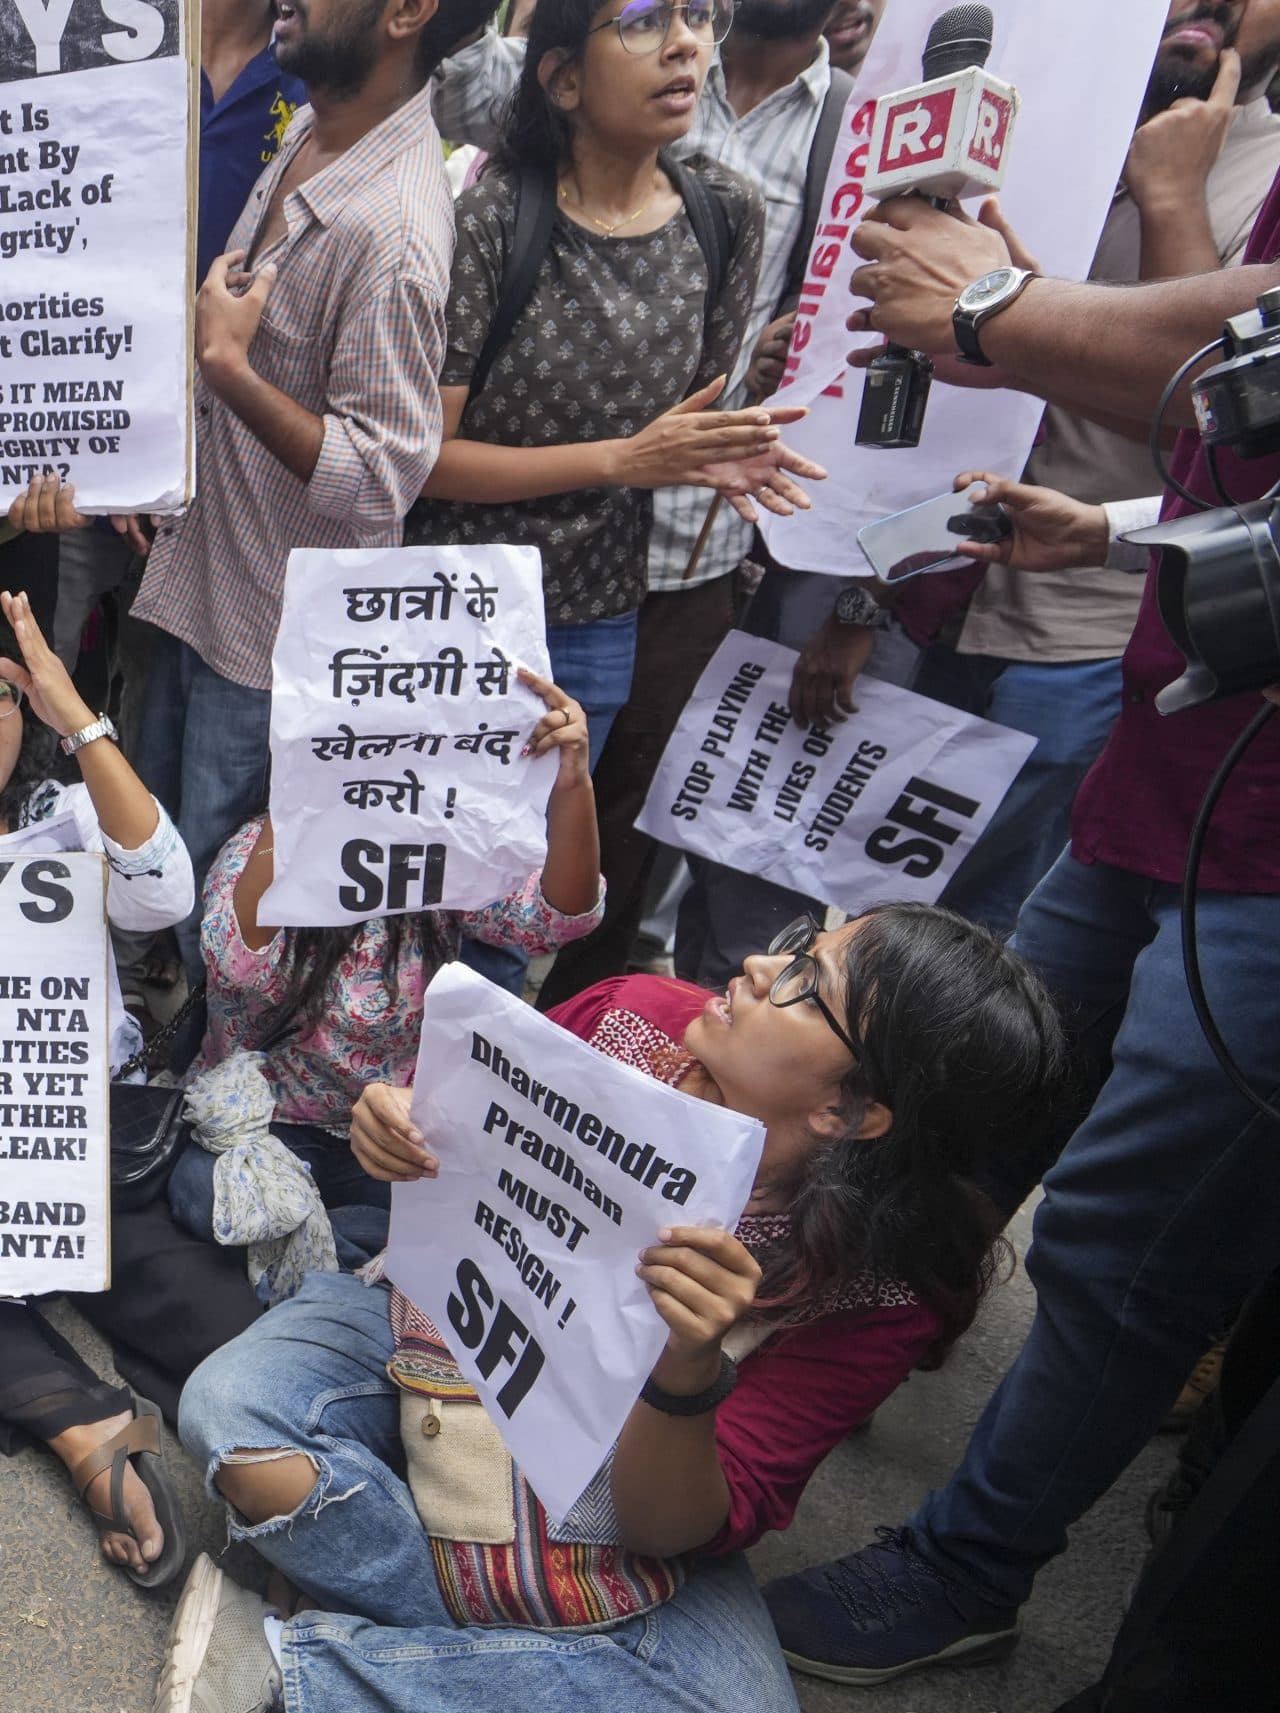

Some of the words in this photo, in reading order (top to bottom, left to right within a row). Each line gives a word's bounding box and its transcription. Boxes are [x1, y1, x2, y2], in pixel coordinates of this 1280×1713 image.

[21, 102, 49, 132] Is
[38, 140, 80, 174] By
[81, 174, 113, 204] of
[20, 325, 133, 360] Clarify!
[10, 383, 36, 404] IT
[43, 380, 124, 403] MEAN
[343, 572, 458, 622] छात्रों
[465, 572, 498, 622] के
[475, 648, 512, 696] से
[312, 724, 447, 761] खेलना
[454, 723, 520, 765] बंद
[670, 760, 716, 821] STOP
[701, 662, 766, 758] PLAYING
[727, 749, 771, 813] WITH
[755, 701, 793, 745] THE
[343, 769, 425, 815] करो
[773, 760, 816, 823] LIVES
[804, 740, 887, 852] STUDENTS
[865, 776, 982, 879] SFI
[339, 838, 447, 912] SFI
[41, 977, 90, 1000] ON
[17, 1008, 89, 1032] NTA
[23, 1072, 88, 1096] YET
[471, 1031, 697, 1206] Dharmendra
[483, 1101, 623, 1226] Pradhan
[497, 1168, 590, 1253] MUST
[1, 1234, 85, 1259] NTA!
[474, 1200, 562, 1310] RESIGN
[447, 1258, 545, 1420] SFI
